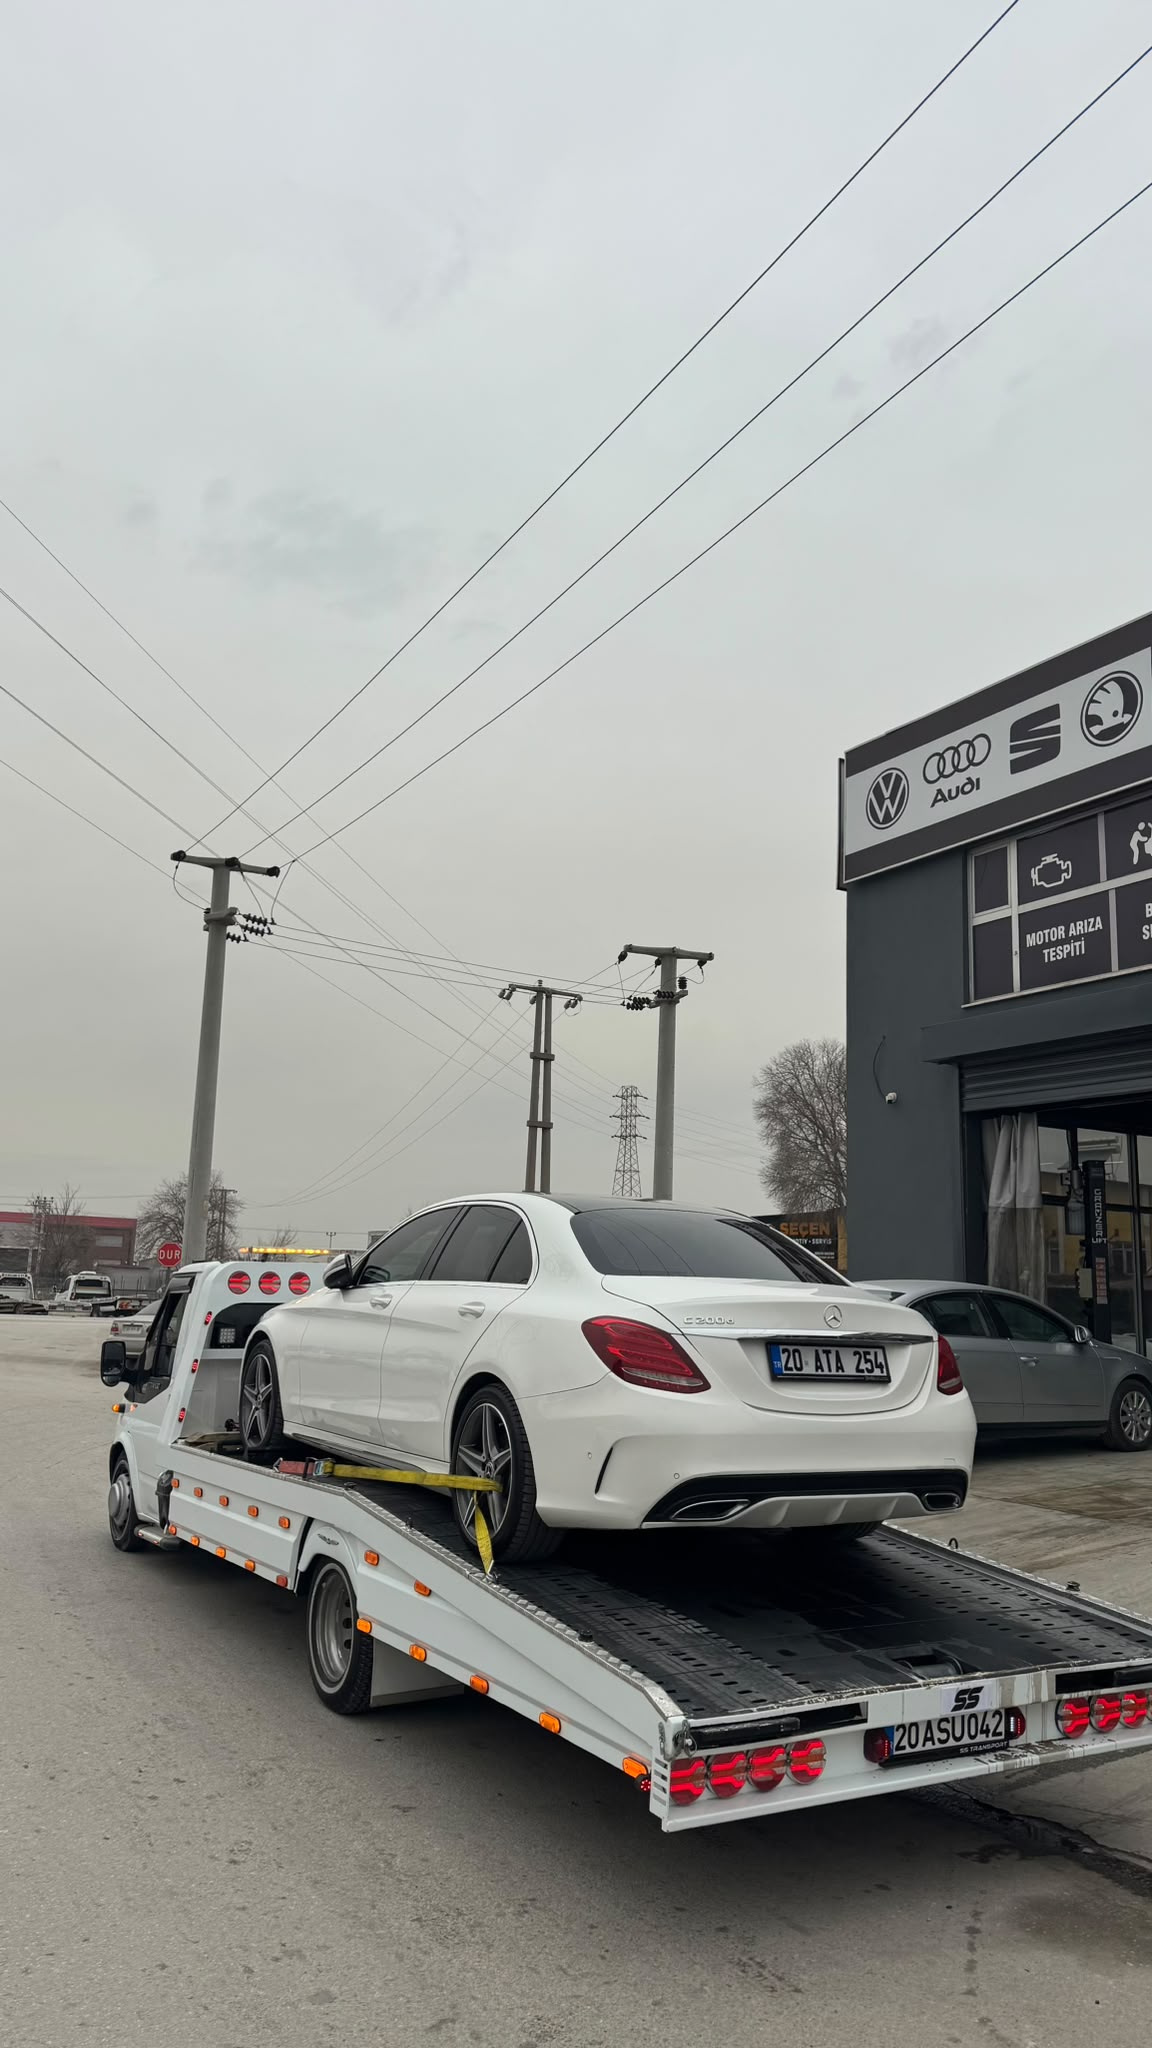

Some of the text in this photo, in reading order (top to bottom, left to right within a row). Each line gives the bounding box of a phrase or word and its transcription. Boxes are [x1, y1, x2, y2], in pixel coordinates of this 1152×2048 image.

[929, 776, 981, 809] Audi
[1026, 916, 1103, 948] MOTOR ARIZA
[1042, 937, 1085, 963] TESPİTİ
[159, 1249, 181, 1260] DUR
[782, 1348, 885, 1374] 20 ATA 254
[951, 1686, 984, 1712] SS
[969, 1741, 1008, 1752] TRANSPORT
